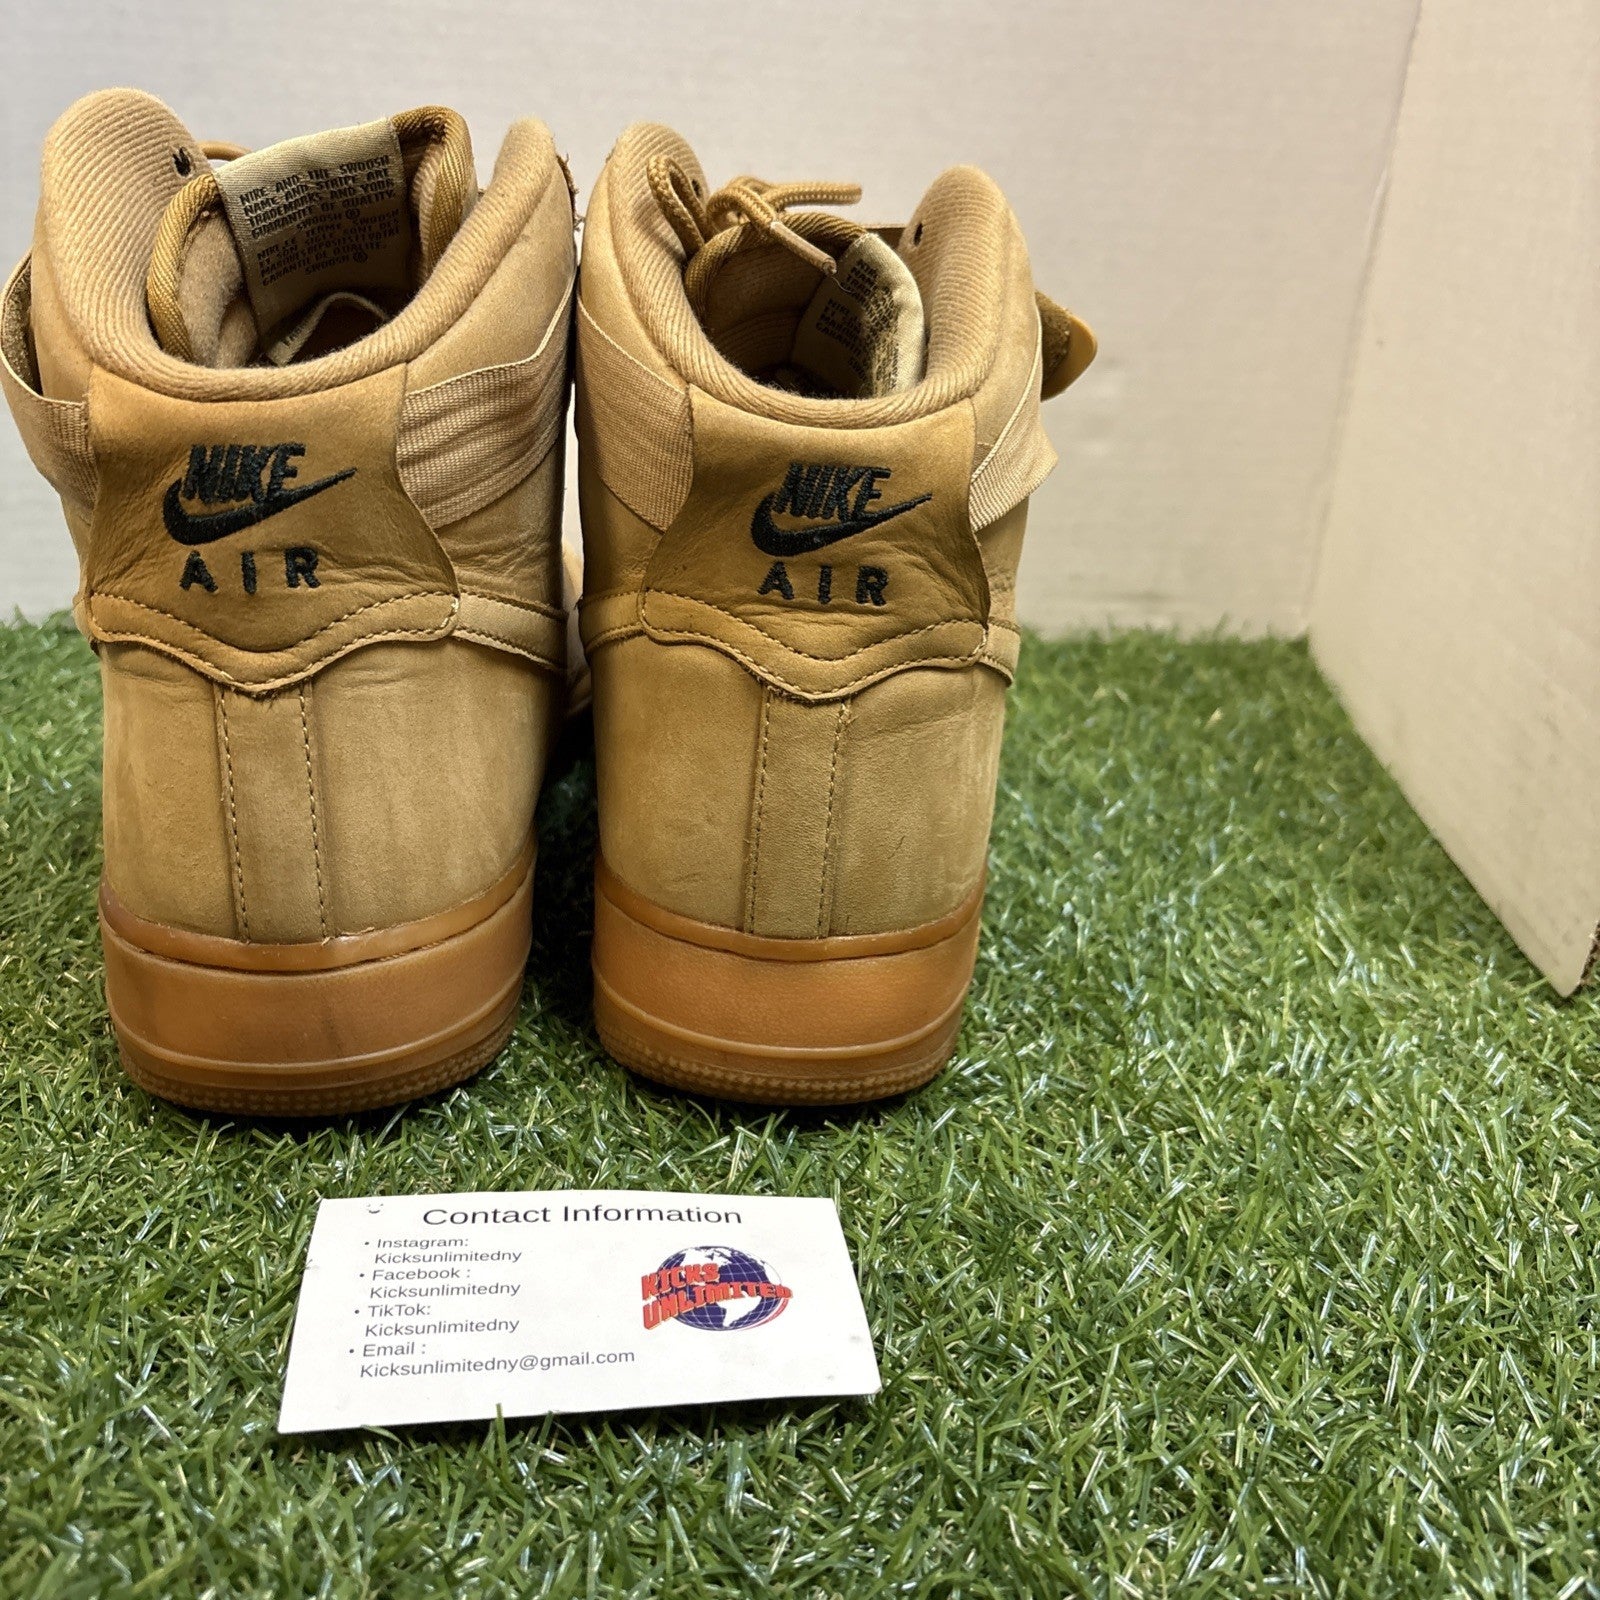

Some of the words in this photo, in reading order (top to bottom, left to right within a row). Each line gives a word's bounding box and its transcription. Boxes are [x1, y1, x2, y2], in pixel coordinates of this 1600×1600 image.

[275, 174, 300, 193] AND
[307, 168, 330, 181] THE
[339, 155, 390, 174] SWOOSH
[243, 197, 279, 216] NAME
[284, 184, 309, 202] AND
[249, 192, 322, 227] TRADEMARKS
[330, 187, 355, 200] AND
[182, 443, 306, 504] NIKE
[772, 462, 892, 521] NIKE
[180, 547, 321, 594] AIR
[757, 561, 888, 606] AIR
[422, 1206, 551, 1225] Contact
[563, 1204, 742, 1223] Information
[374, 1250, 522, 1265] Kicksunlimitedny
[377, 1237, 469, 1250] Instagram:
[372, 1267, 461, 1281] Facebook
[641, 1262, 720, 1300] KICKS
[370, 1282, 521, 1299] Kicksunlimitedny
[367, 1303, 431, 1318] TikTok:
[642, 1281, 793, 1330] UNLIMITED
[365, 1318, 520, 1338] Kicksunlimitedny
[363, 1341, 415, 1357] Email
[360, 1351, 635, 1378] Kicksunlimitedny@gmail.com
